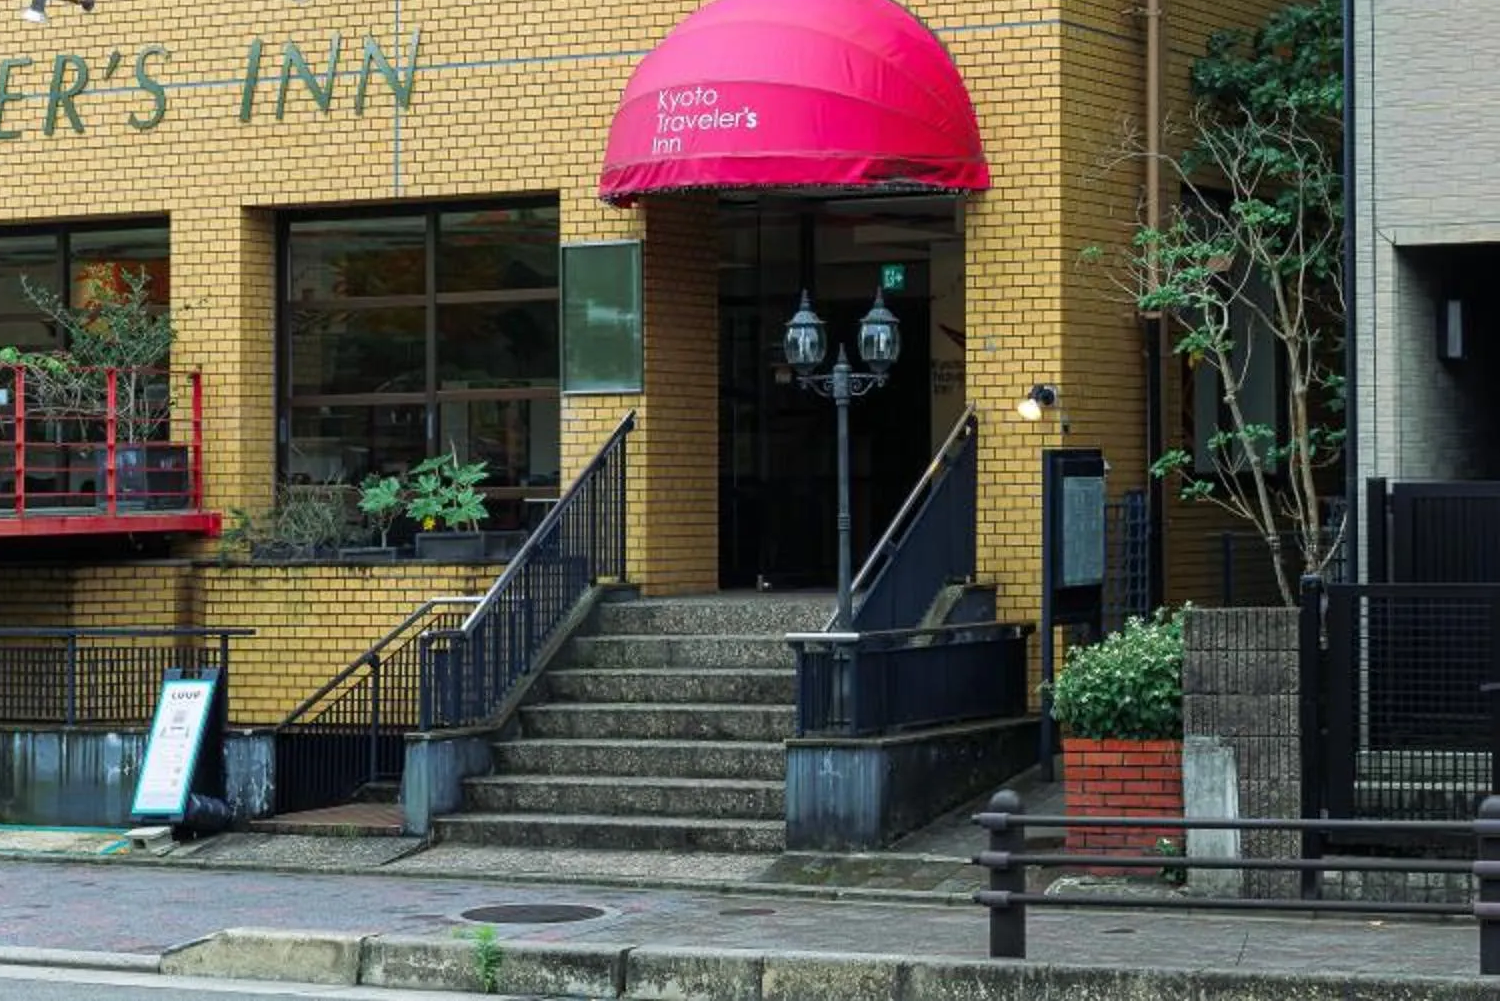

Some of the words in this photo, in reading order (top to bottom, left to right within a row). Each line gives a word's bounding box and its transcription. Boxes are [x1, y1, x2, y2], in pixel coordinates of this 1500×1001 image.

[239, 27, 421, 124] INN
[657, 86, 718, 114] Kyoto
[656, 106, 757, 134] Traveler's
[651, 136, 682, 155] Inn
